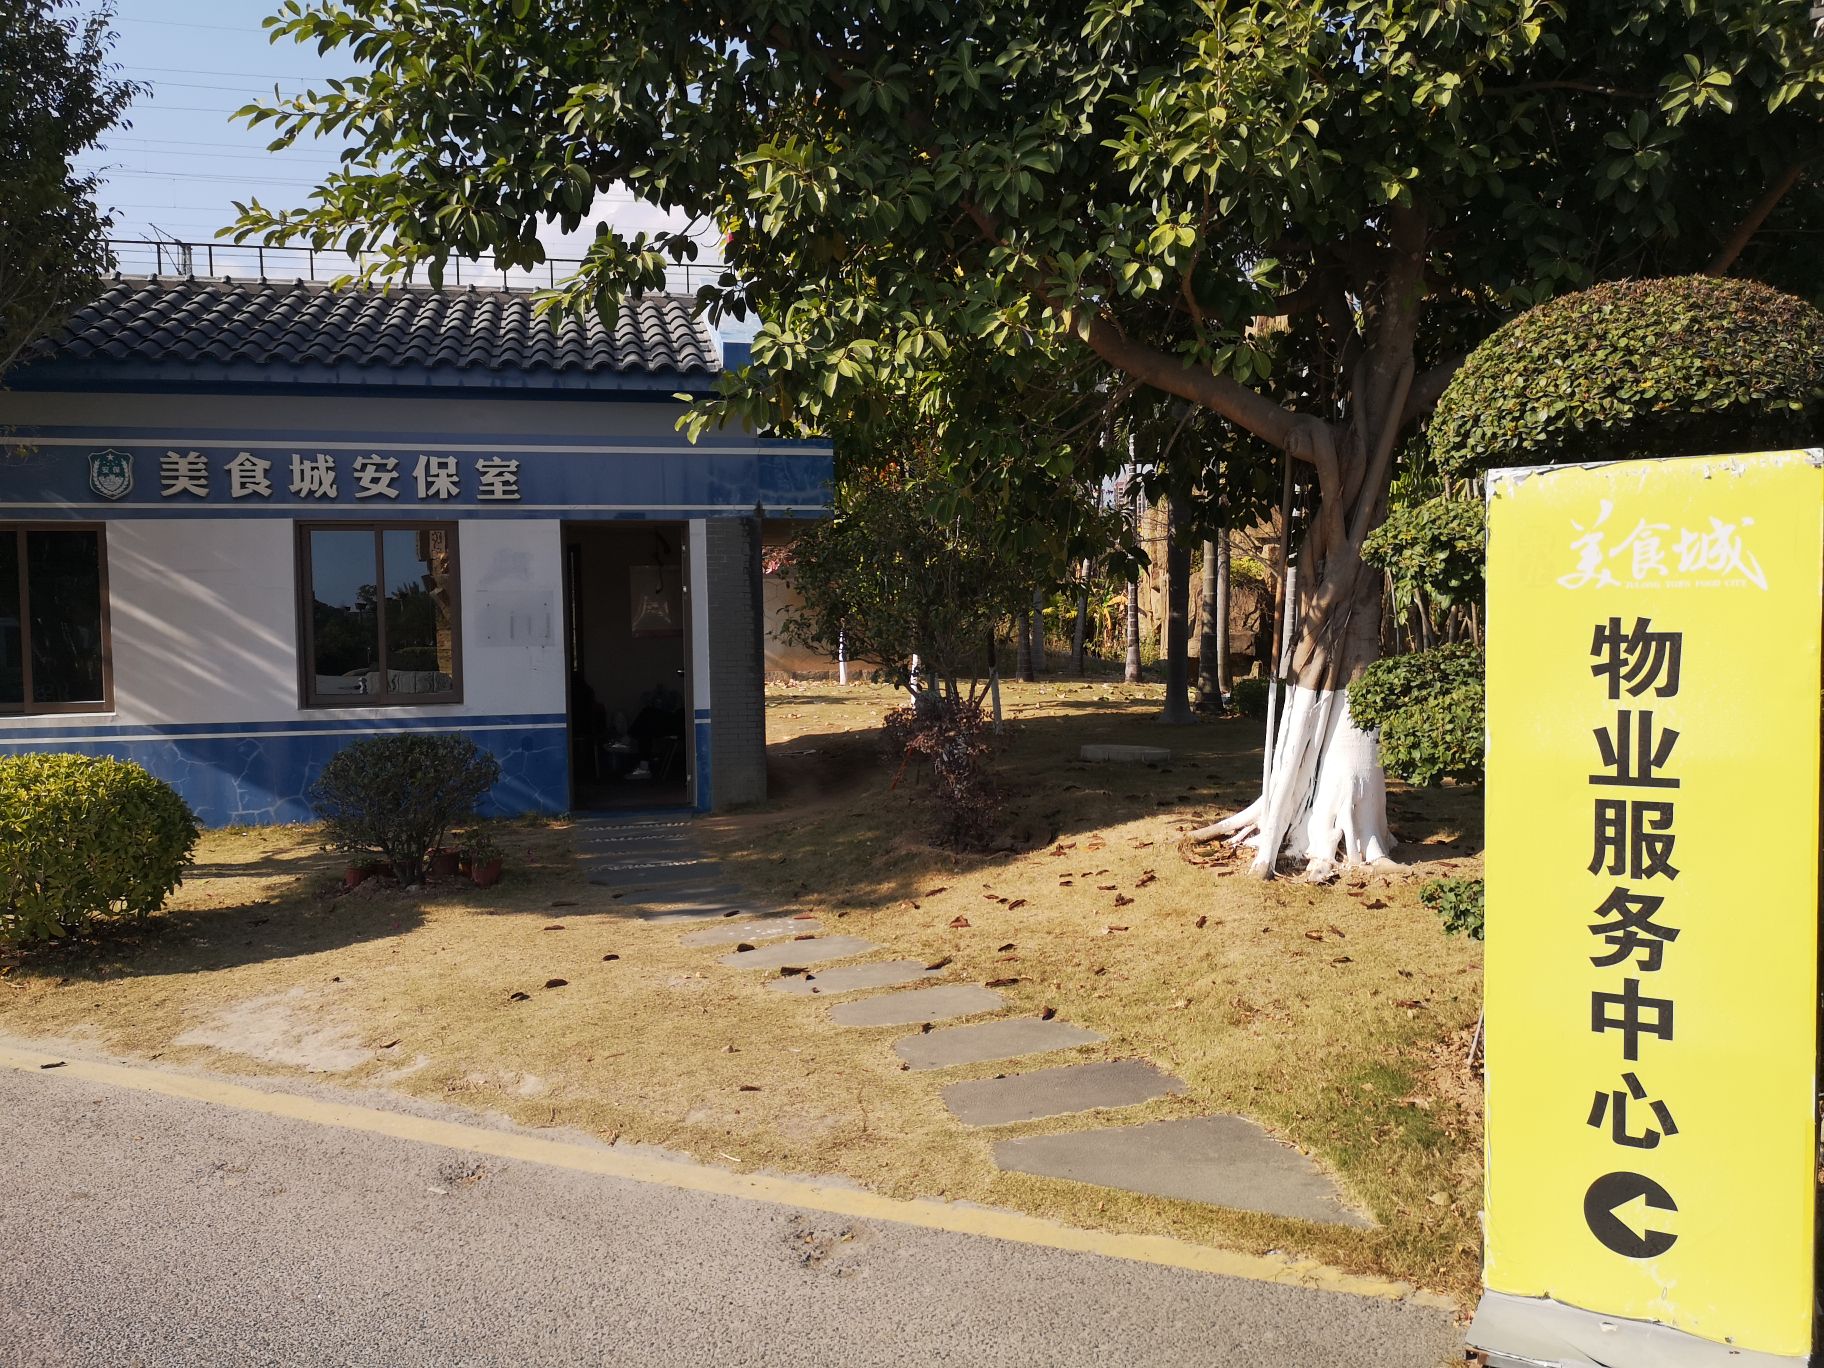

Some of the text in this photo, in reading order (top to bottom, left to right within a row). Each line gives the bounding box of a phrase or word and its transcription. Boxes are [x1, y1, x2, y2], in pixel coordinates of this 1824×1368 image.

[159, 449, 522, 500] 美食城安保室
[1557, 500, 1768, 591] 美食城
[1586, 617, 1683, 1149] 物业服务中心
